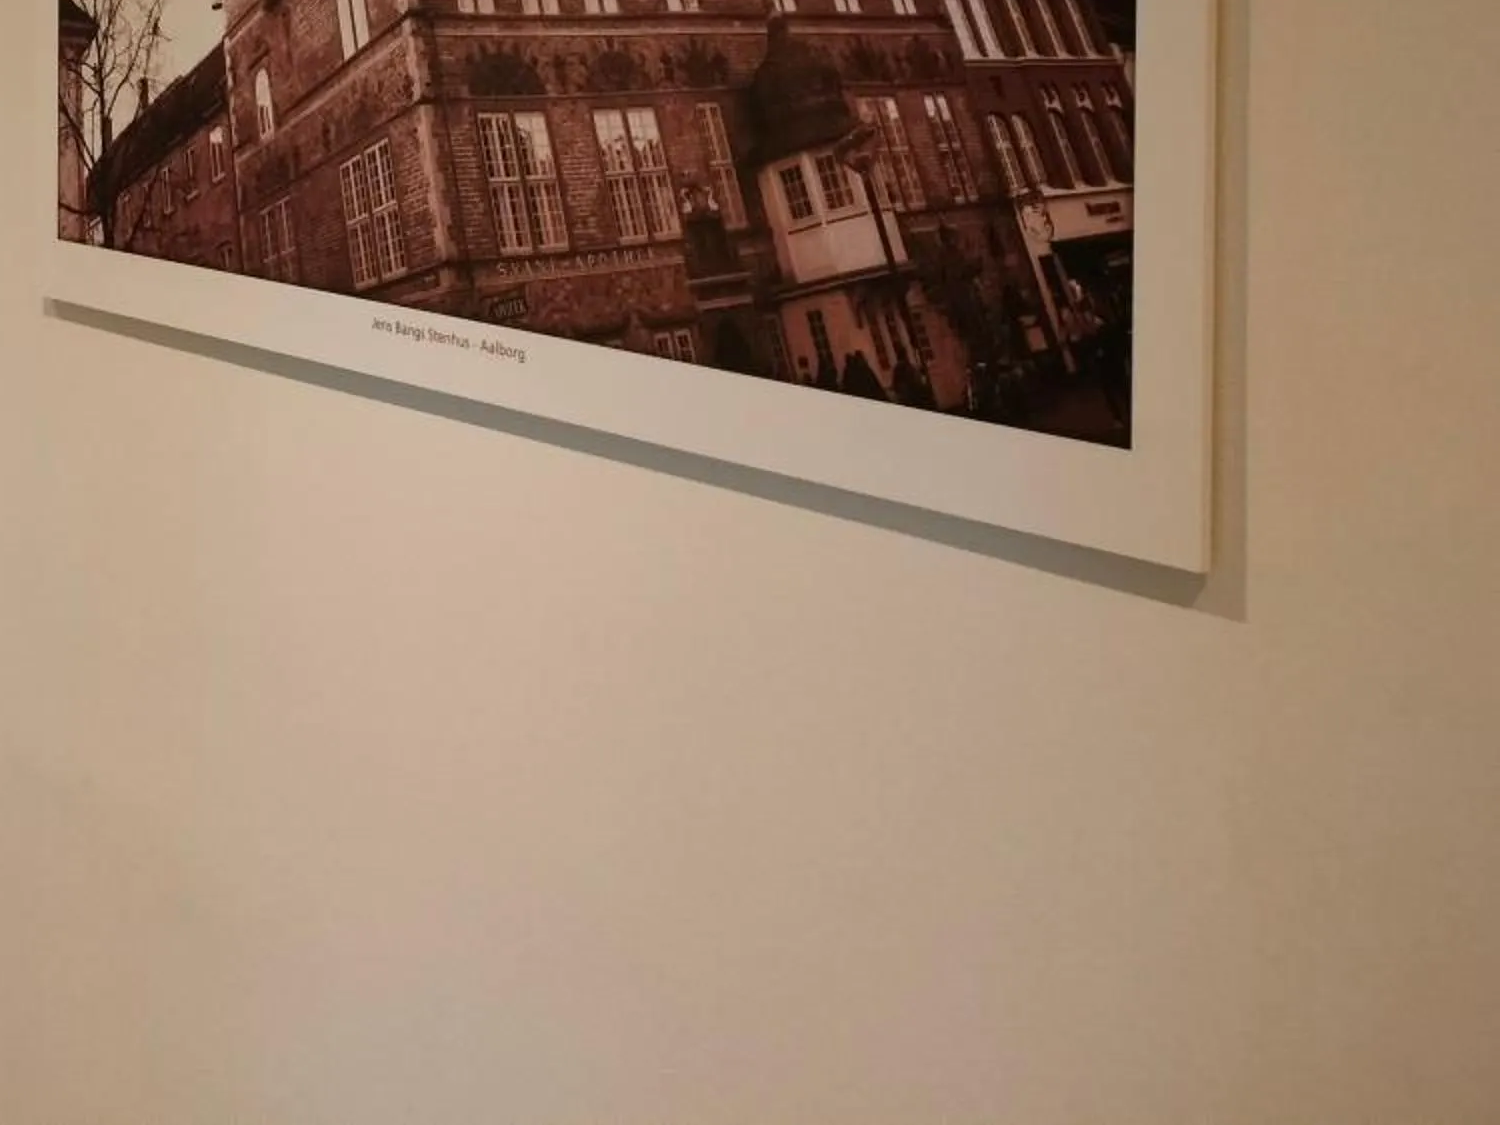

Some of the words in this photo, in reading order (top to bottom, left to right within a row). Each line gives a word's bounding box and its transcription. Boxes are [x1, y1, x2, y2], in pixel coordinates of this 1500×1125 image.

[371, 316, 393, 332] Jens
[427, 326, 470, 349] Stenhus
[480, 338, 526, 363] Aalborg
